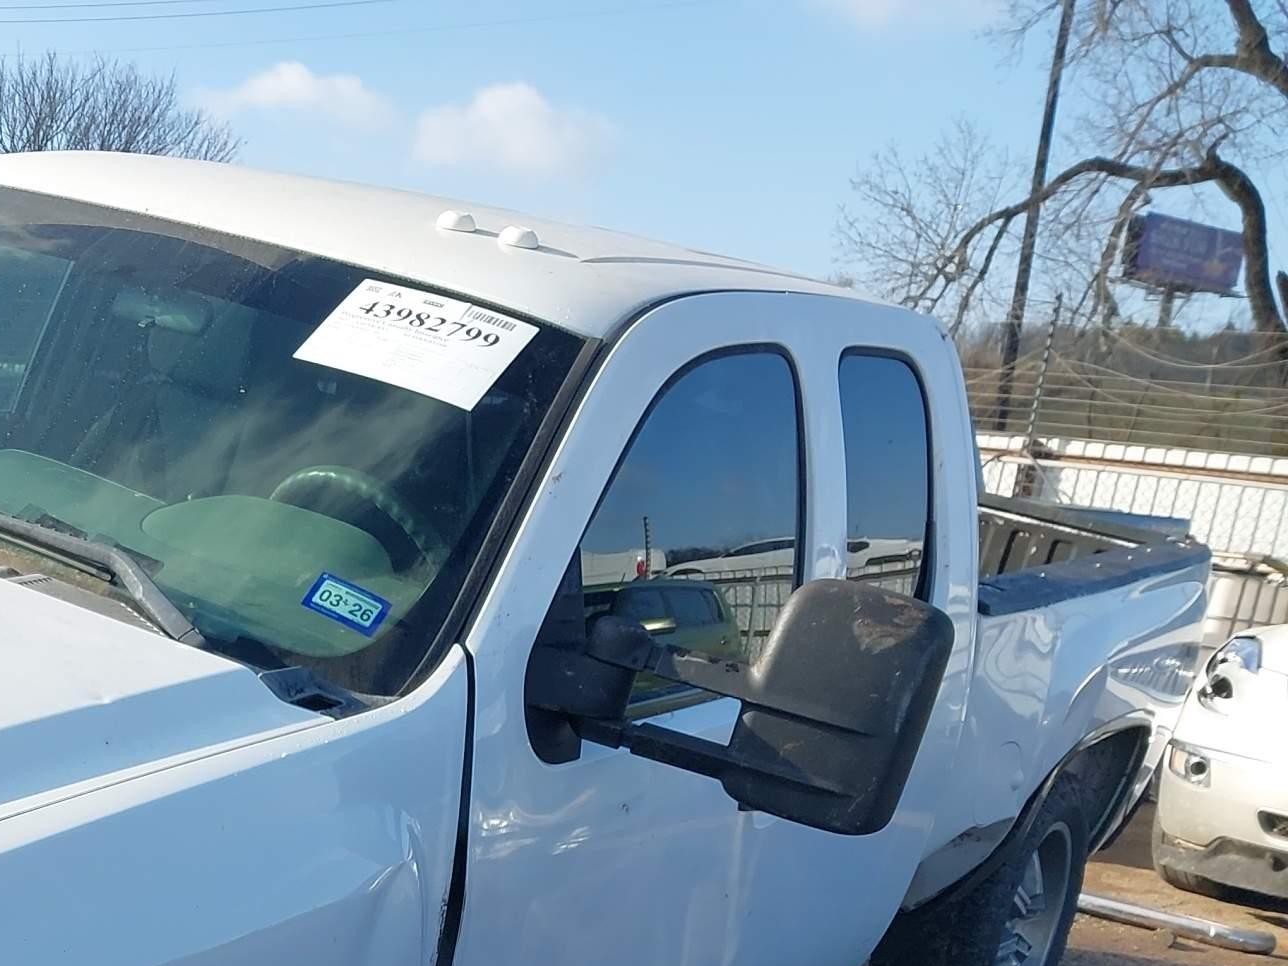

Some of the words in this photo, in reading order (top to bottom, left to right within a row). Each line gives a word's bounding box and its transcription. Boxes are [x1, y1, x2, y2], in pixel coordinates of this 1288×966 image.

[359, 301, 501, 348] 43982799
[319, 589, 344, 607] 03
[348, 603, 374, 622] 26
